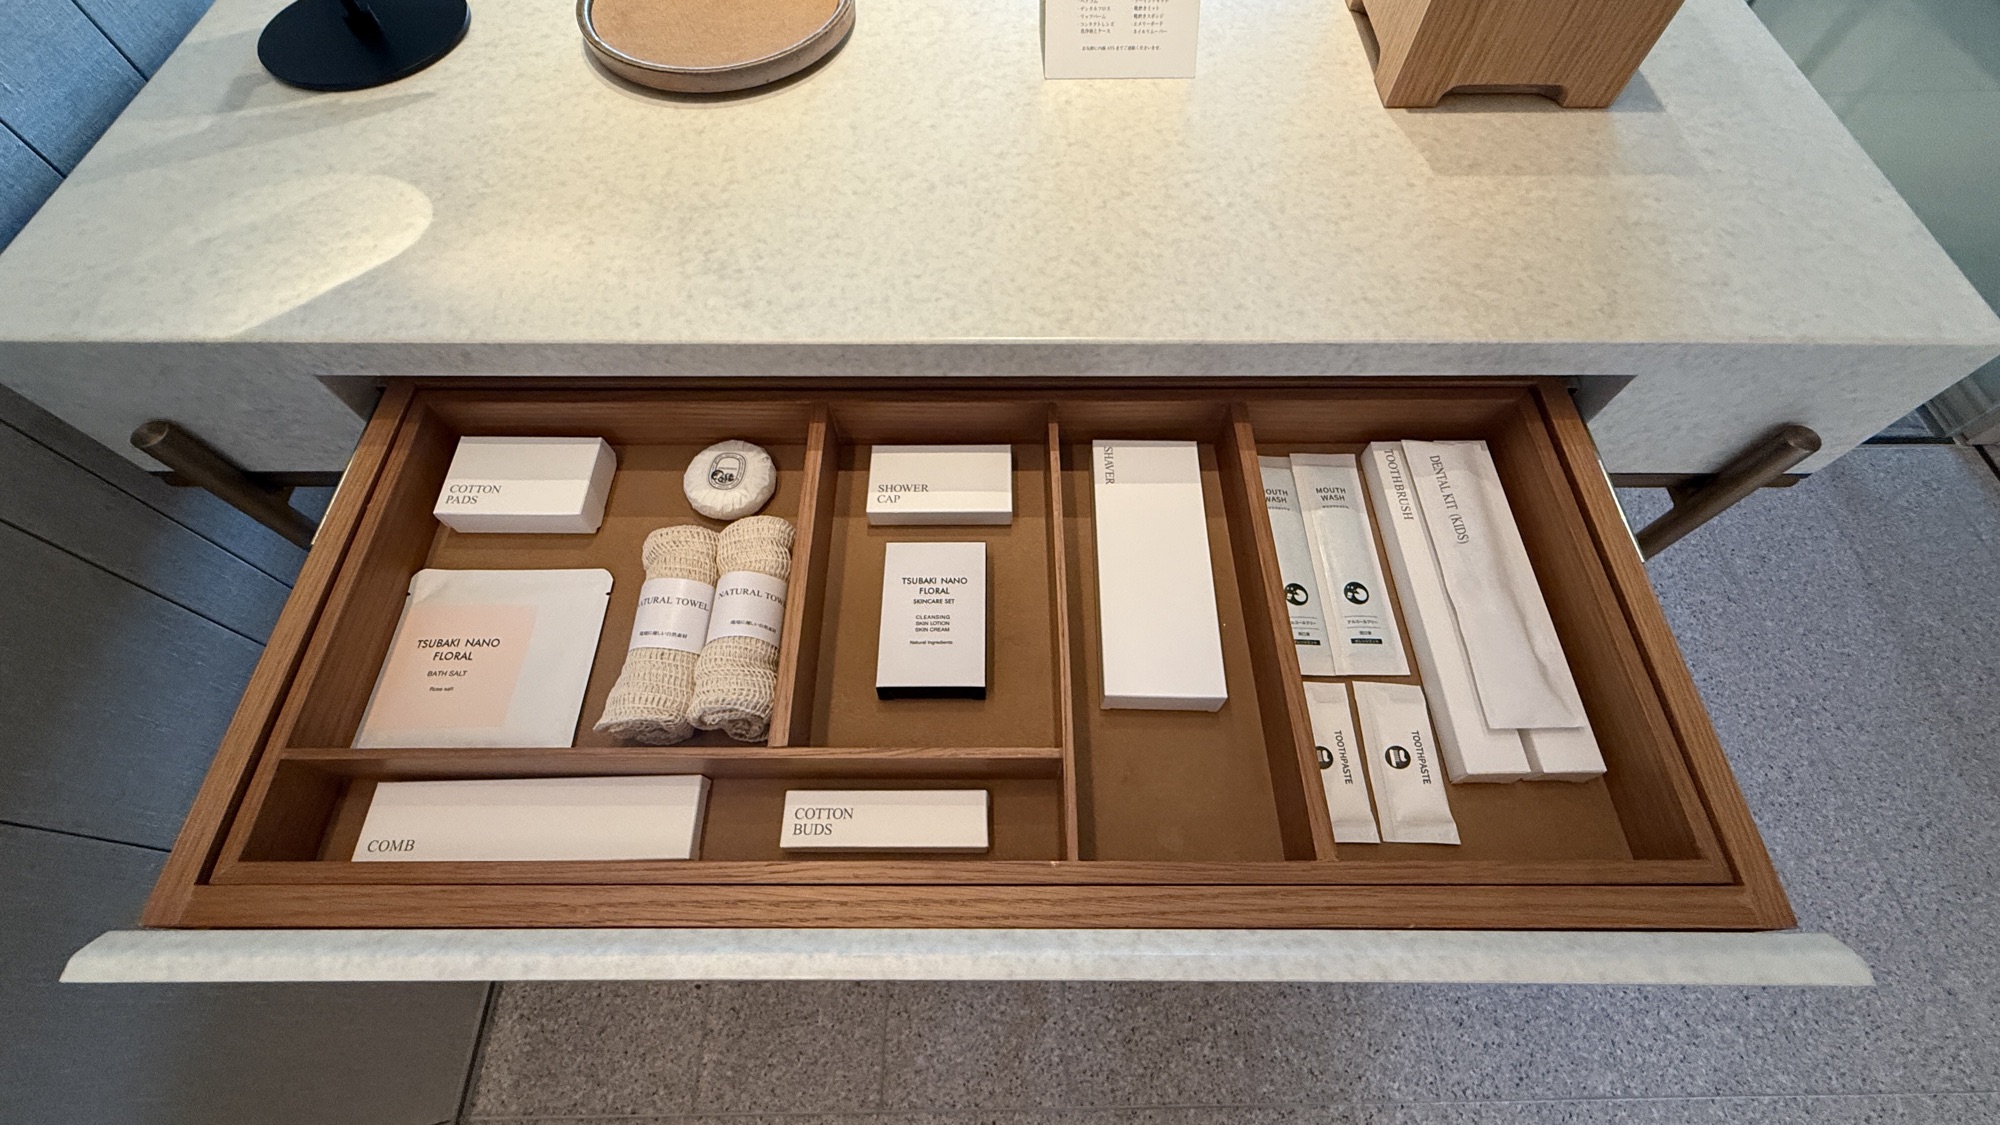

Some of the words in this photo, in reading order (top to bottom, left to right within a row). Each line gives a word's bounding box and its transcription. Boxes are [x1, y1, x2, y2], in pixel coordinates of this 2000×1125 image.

[1103, 445, 1115, 485] SHAVER
[1429, 454, 1451, 493] DENTAL
[449, 484, 502, 494] COTTON
[878, 484, 929, 492] SHOWER
[1315, 486, 1347, 494] MOUTH
[1384, 448, 1414, 521] TOOTHBRUSH
[1265, 488, 1289, 496] OUTH
[445, 495, 478, 505] PADS
[877, 494, 901, 503] CAP
[1442, 493, 1459, 510] KIT
[1448, 513, 1469, 545] (KIDS)
[902, 577, 937, 585] TSUBAKI
[940, 577, 968, 585] NANO
[718, 587, 763, 599] NATURAL
[919, 587, 950, 595] FLORAL
[675, 597, 710, 611] TOWEL
[417, 639, 461, 648] TSUBAKI
[465, 638, 501, 648] NANO
[433, 651, 473, 661] FLORAL
[1334, 730, 1353, 785] TOOTHPASTE
[1411, 730, 1432, 785] TOOTHPASTE
[794, 807, 854, 820] COTTON
[792, 823, 833, 836] BUDS
[367, 839, 416, 853] COMB
